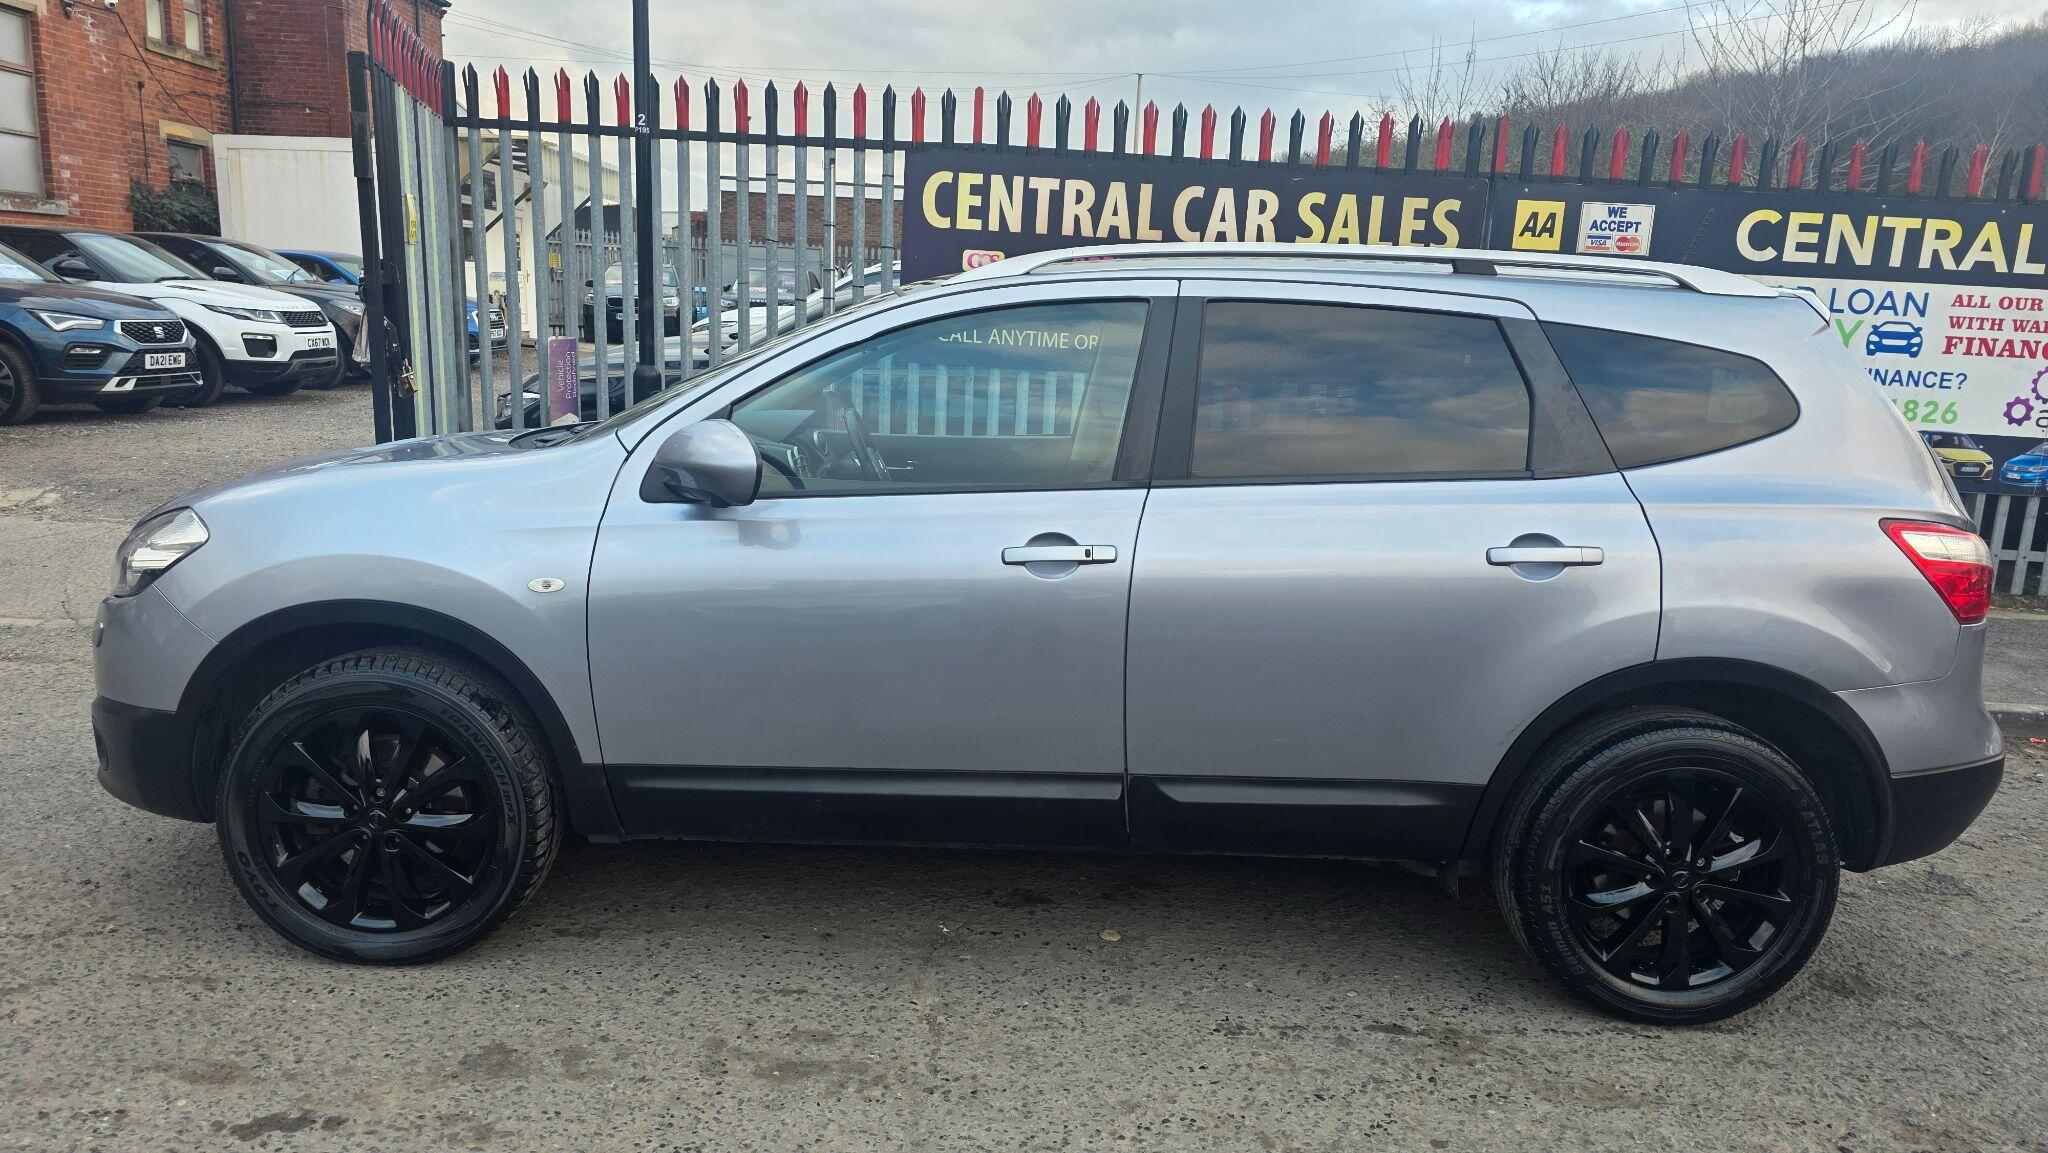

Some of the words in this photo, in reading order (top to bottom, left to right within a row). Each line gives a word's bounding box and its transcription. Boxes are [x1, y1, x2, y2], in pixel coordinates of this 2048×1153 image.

[637, 113, 646, 126] 2
[922, 170, 1163, 242] CENTRAL
[1172, 185, 1280, 243] CAR
[1295, 191, 1462, 248] SALES
[1608, 206, 1628, 219] WE
[1518, 211, 1557, 238] AA
[1589, 219, 1642, 234] ACCEPT
[1590, 239, 1607, 247] VISA
[1736, 208, 2046, 275] CENTRAL
[1829, 287, 1930, 318] LOAN
[1950, 293, 1992, 309] ALL
[1998, 296, 2044, 311] OUR
[1948, 315, 2005, 332] WITH
[988, 328, 1069, 349] ANYTIME
[150, 355, 167, 367] DA21
[555, 360, 565, 393] Vehicle
[1864, 367, 1968, 391] NANCE?
[1891, 398, 1959, 425] 826
